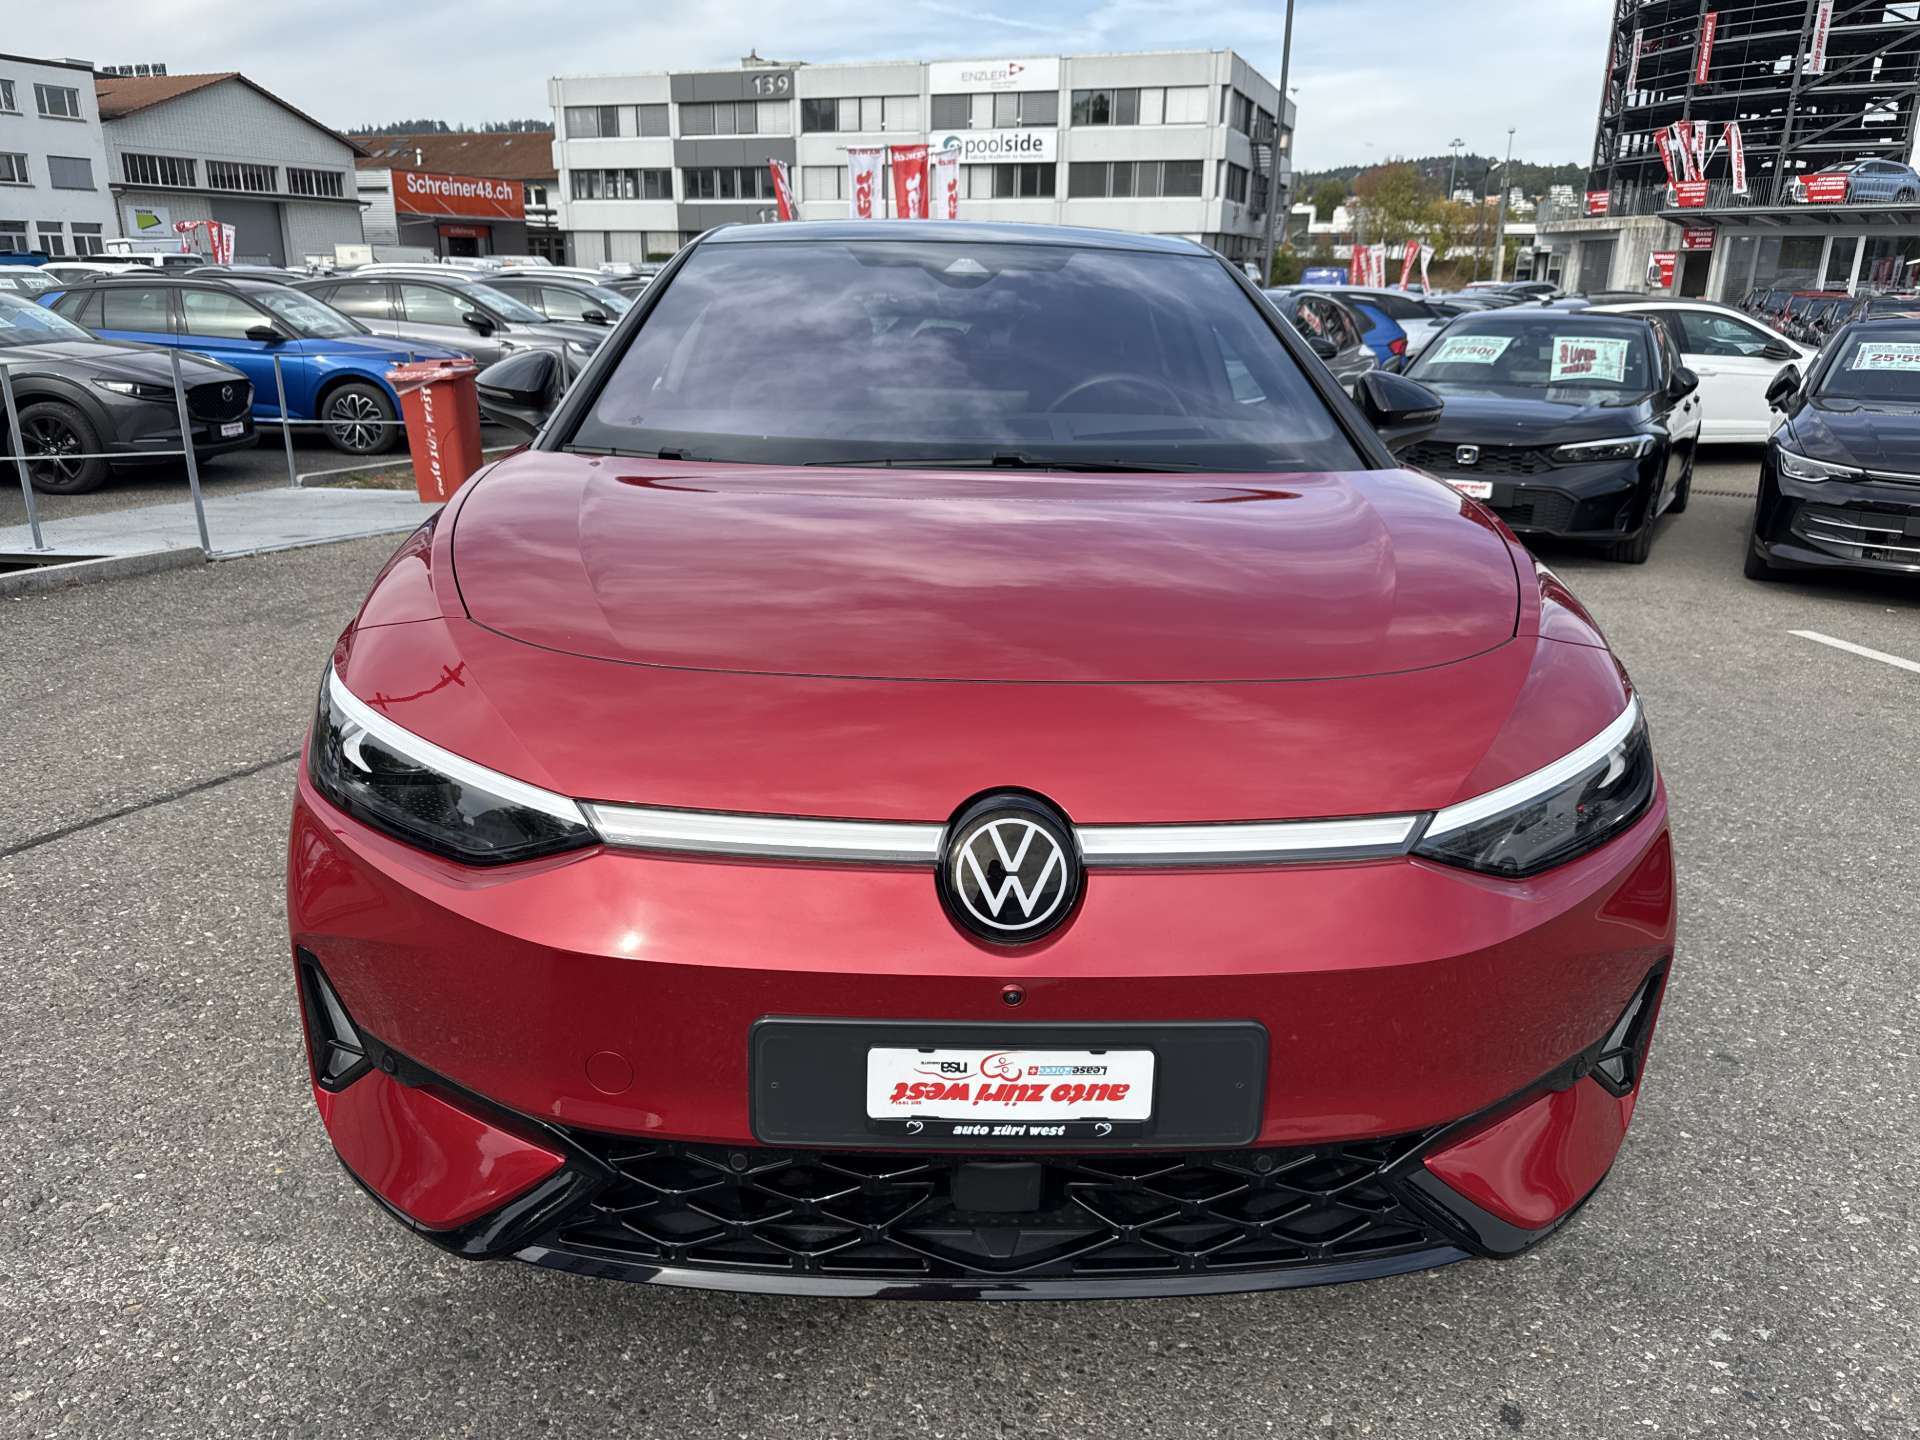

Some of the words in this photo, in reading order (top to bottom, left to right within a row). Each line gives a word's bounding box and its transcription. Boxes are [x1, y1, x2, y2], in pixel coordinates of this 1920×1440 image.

[752, 73, 789, 95] 139
[961, 70, 1008, 81] ENZLER
[965, 133, 1043, 160] poolside
[406, 173, 513, 200] Schreiner48.ch
[961, 822, 1061, 918] VW
[941, 1062, 967, 1073] nsa
[1039, 1066, 1108, 1075] LeaseForce
[890, 1082, 970, 1104] west
[973, 1083, 1051, 1106] züri
[1051, 1083, 1130, 1105] auto
[953, 1125, 990, 1136] auto
[992, 1124, 1027, 1136] züri
[1028, 1125, 1066, 1136] west
